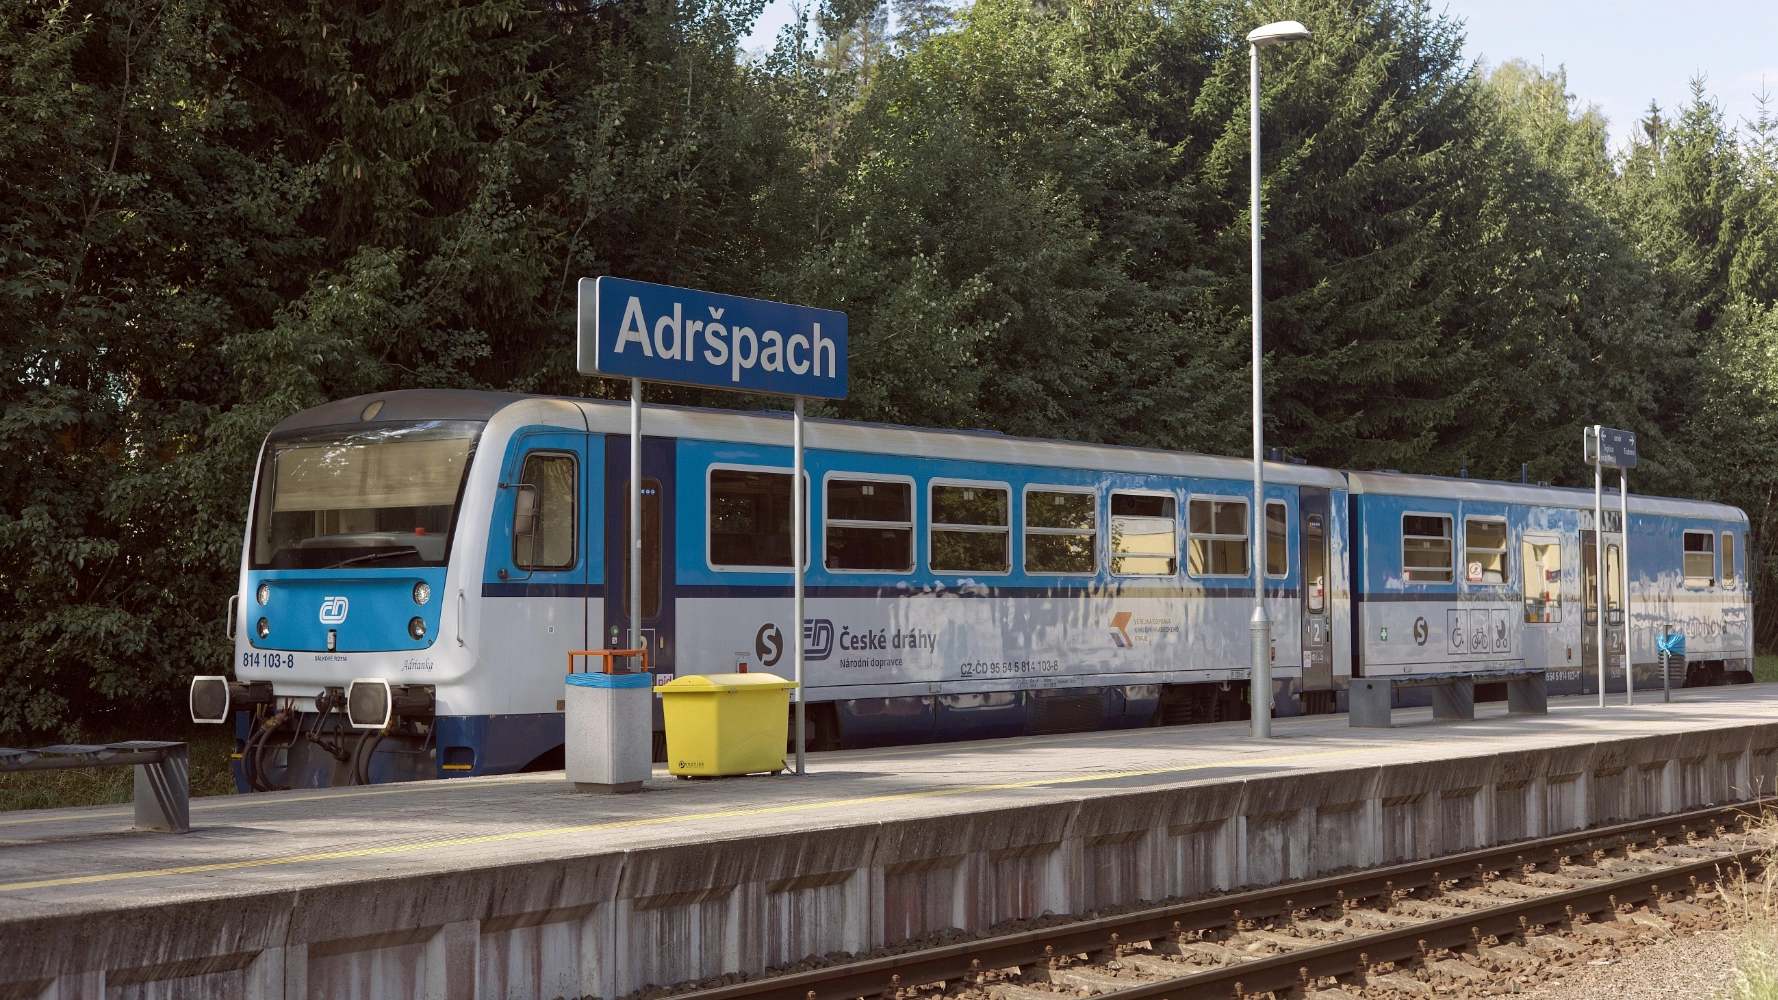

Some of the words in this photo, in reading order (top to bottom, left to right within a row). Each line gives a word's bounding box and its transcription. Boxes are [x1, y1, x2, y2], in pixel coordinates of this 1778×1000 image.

[613, 295, 836, 382] Adršpach
[839, 625, 887, 651] České
[891, 628, 937, 654] dráhy
[1313, 623, 1321, 642] 2
[1612, 632, 1618, 649] 2
[242, 652, 260, 668] 814
[262, 652, 294, 668] 103-8
[401, 658, 434, 672] Adrianka
[839, 657, 869, 668] Národní
[870, 656, 903, 668] dopravce
[960, 660, 988, 677] CZ-ČD
[990, 662, 1000, 674] 95
[1002, 662, 1013, 673] 54
[1014, 661, 1020, 672] 5
[1021, 661, 1036, 672] 814
[1037, 660, 1059, 672] 103-8
